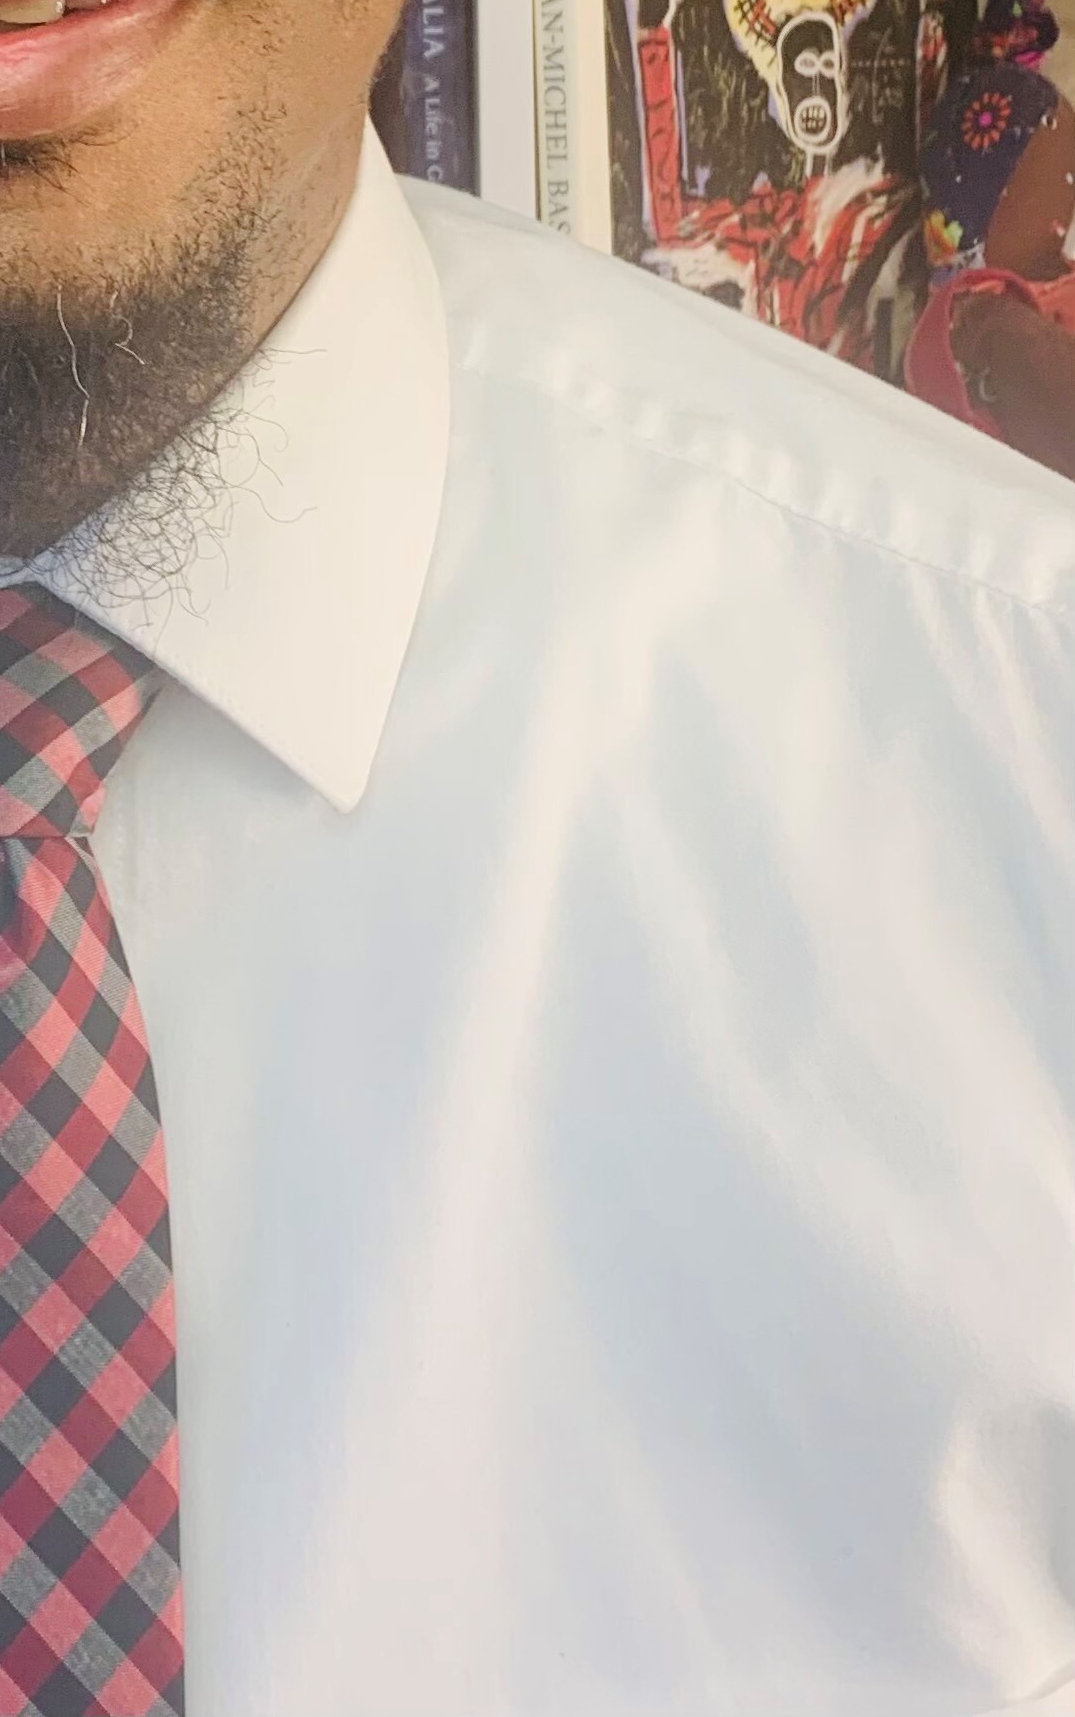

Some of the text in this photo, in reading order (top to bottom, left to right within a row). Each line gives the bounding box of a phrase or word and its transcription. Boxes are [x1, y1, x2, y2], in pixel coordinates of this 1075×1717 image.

[425, 97, 443, 133] Life
[426, 139, 443, 160] in
[547, 178, 572, 238] BAS
